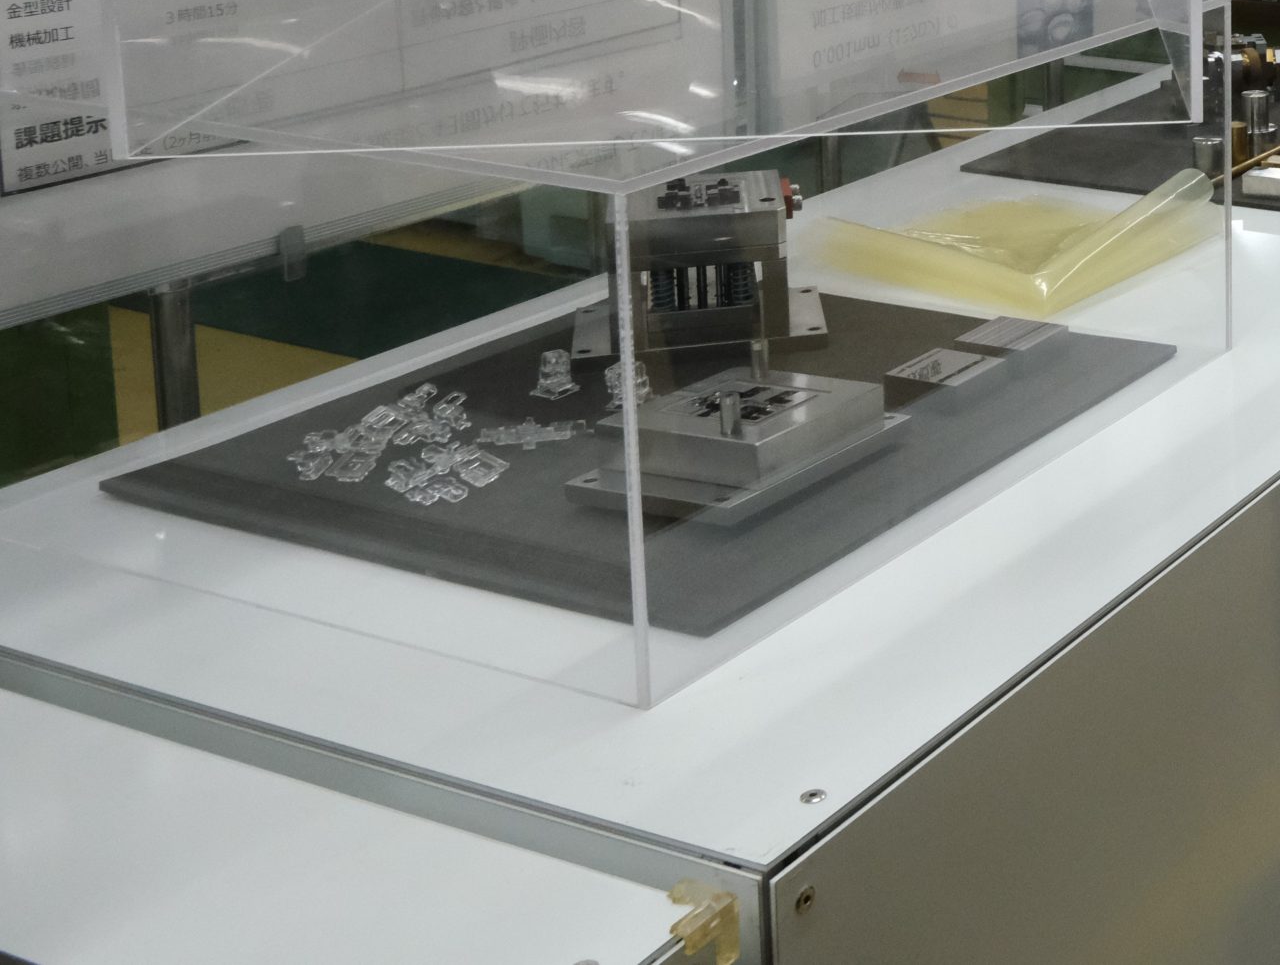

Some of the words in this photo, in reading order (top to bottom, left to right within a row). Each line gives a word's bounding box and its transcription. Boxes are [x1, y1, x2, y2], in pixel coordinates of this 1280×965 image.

[8, 25, 75, 51] 機械加工
[14, 115, 108, 150] 課題提示
